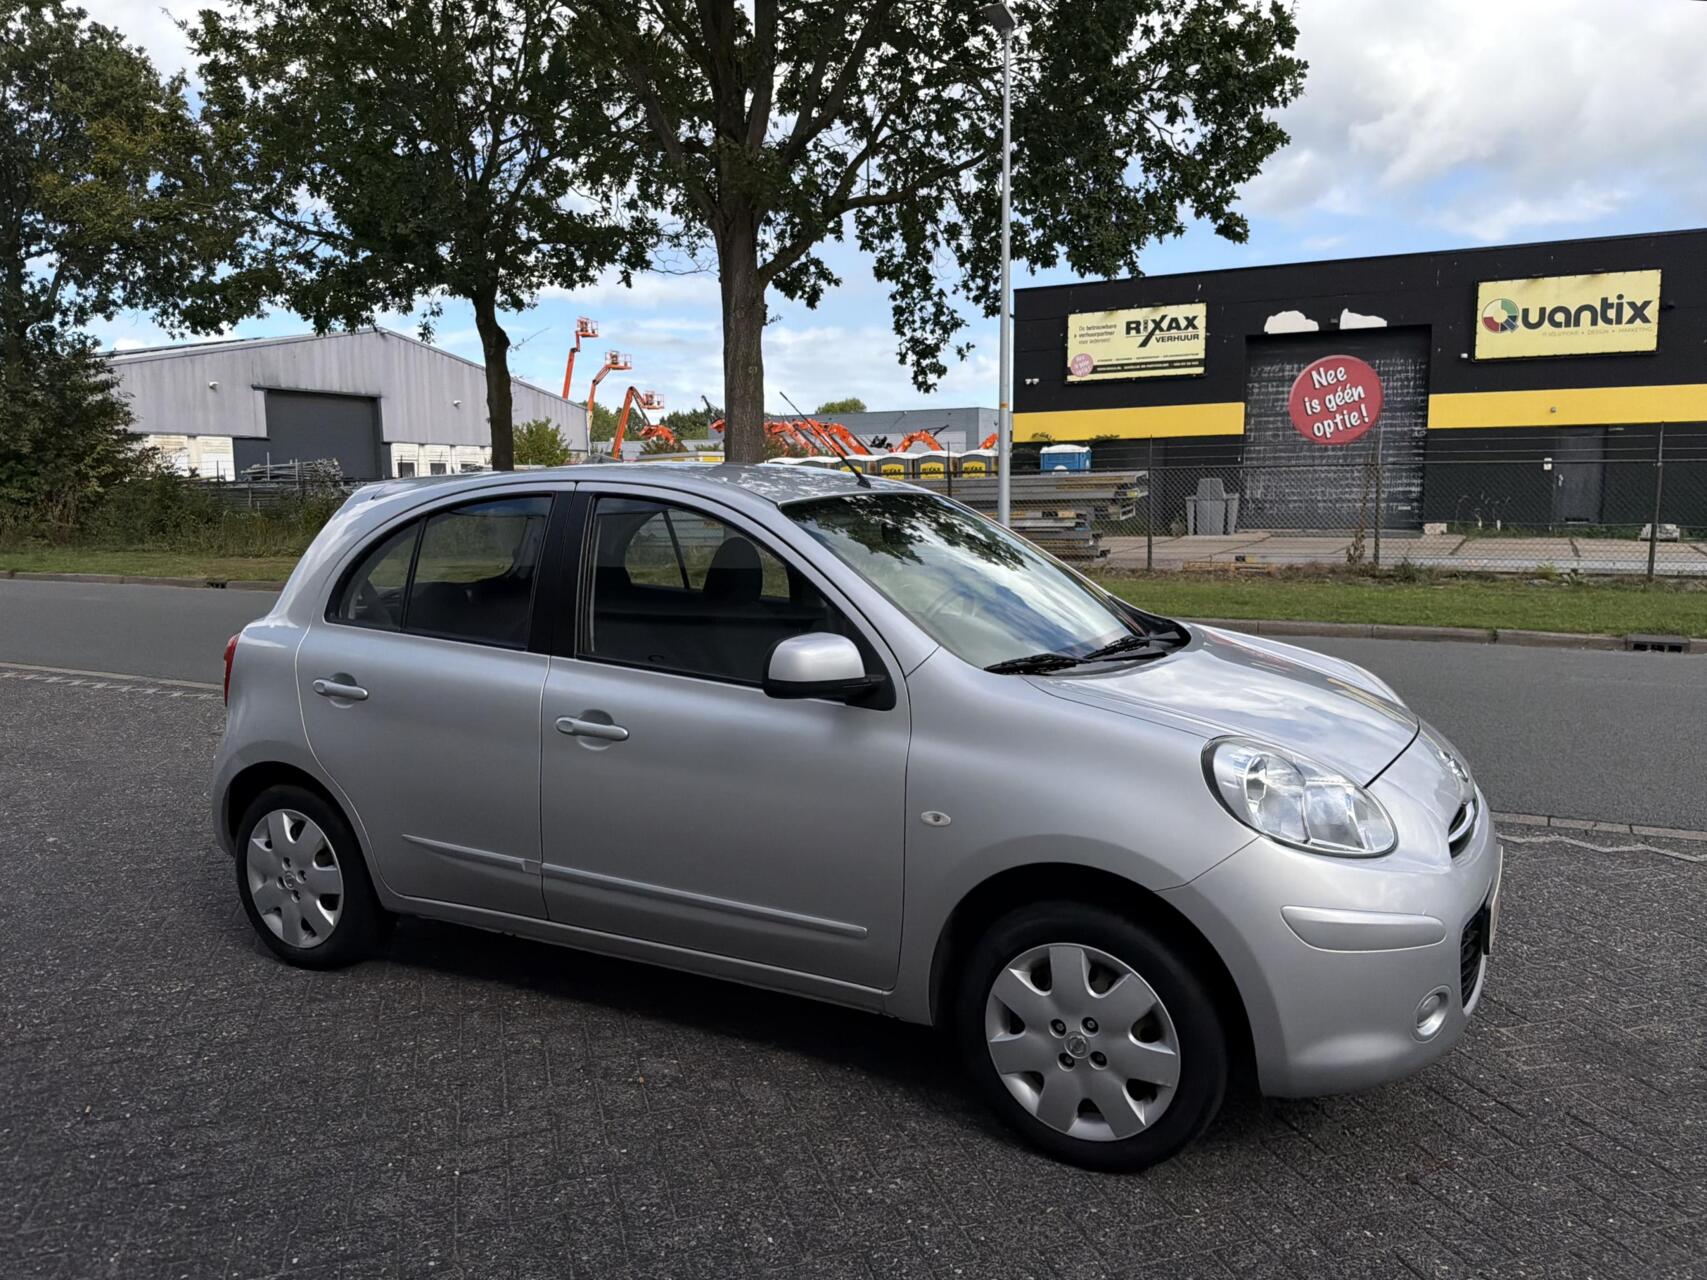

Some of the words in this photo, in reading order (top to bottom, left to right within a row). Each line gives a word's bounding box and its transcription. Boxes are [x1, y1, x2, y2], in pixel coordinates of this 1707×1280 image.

[1482, 293, 1653, 333] Quantix
[1155, 334, 1200, 343] VERHUUR
[1311, 367, 1347, 389] Nee
[1304, 397, 1321, 415] is
[1325, 384, 1366, 411] géén
